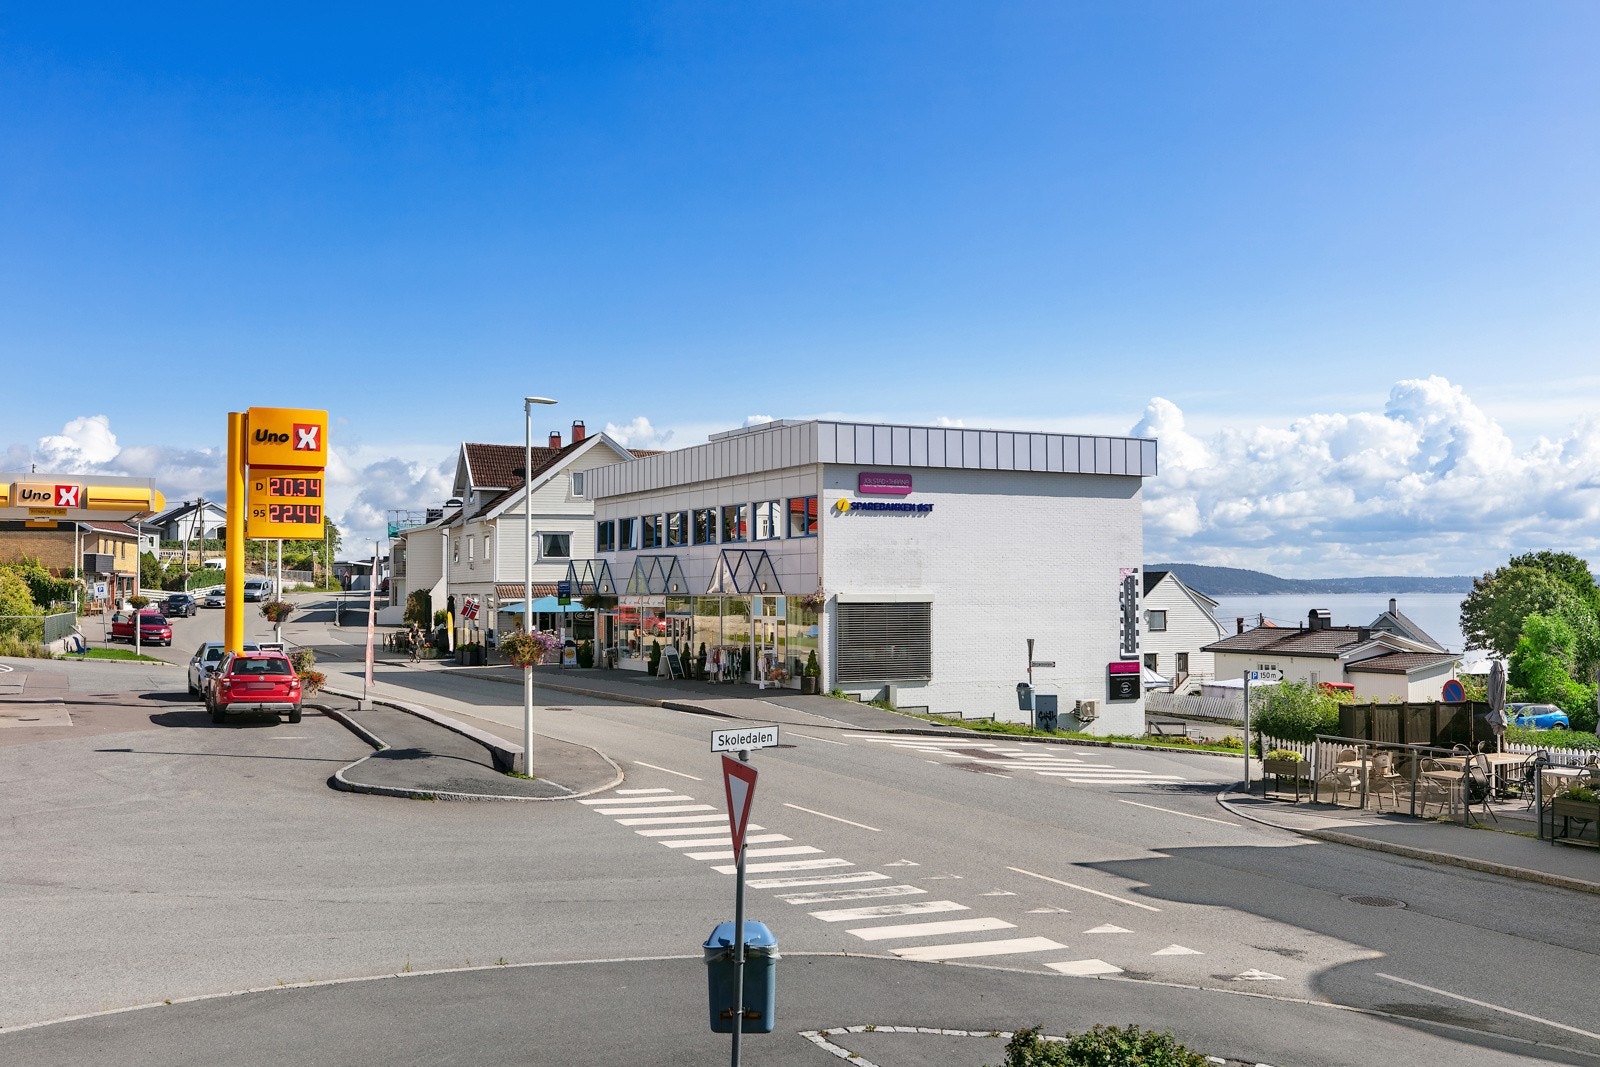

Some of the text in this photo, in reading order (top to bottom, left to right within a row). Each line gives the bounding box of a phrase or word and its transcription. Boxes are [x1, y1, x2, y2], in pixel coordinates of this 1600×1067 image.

[255, 426, 319, 449] Uno X
[22, 486, 78, 506] Uno X
[255, 478, 320, 497] D 20.34
[253, 505, 320, 524] 95 22.44
[850, 501, 916, 511] SPAREBANKEN
[718, 732, 773, 746] Skoledalen
